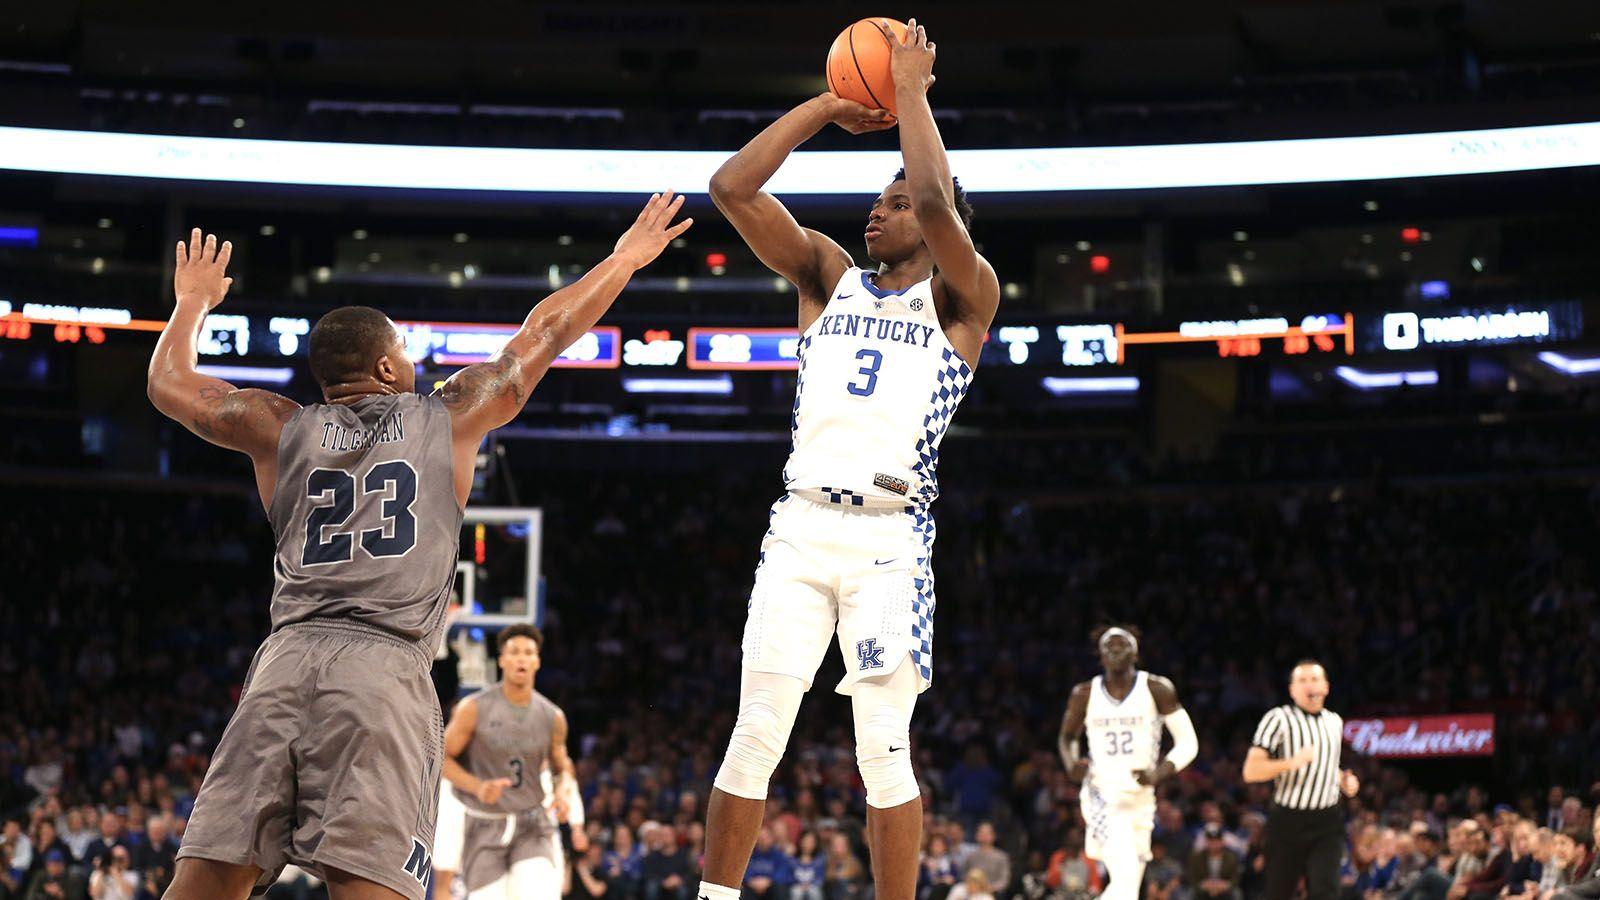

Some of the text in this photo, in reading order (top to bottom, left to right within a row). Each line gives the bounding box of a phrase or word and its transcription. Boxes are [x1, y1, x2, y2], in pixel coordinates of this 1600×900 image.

[819, 314, 934, 348] KENTUCKY
[847, 349, 883, 397] 3
[300, 459, 418, 568] 23
[1105, 731, 1133, 756] 32
[1344, 719, 1491, 756] Budweiser
[510, 757, 523, 788] 3
